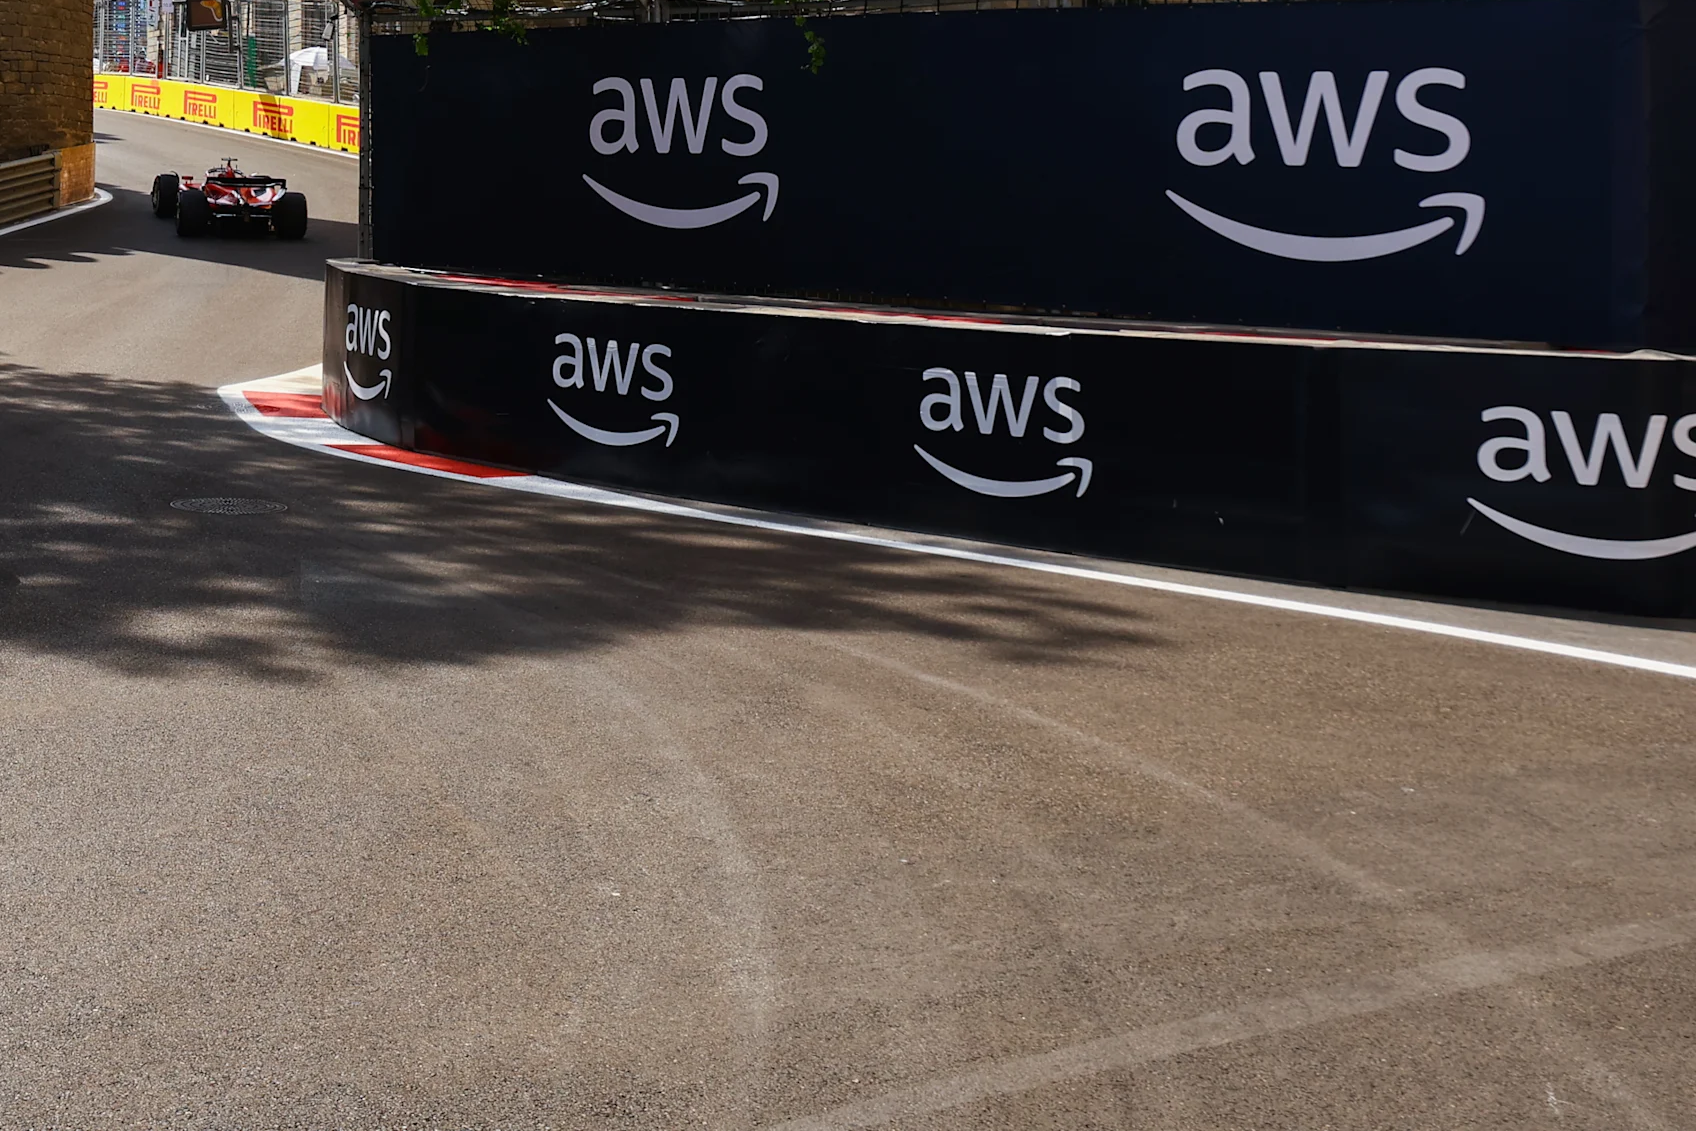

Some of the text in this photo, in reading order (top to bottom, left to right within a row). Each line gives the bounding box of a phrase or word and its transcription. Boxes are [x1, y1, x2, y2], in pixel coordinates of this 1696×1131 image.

[93, 81, 109, 104] ELLI
[131, 83, 161, 110] PIRELLI
[184, 90, 217, 119] PIRELLI
[253, 101, 294, 134] PIRELLI
[590, 74, 768, 157] aws
[1176, 67, 1471, 172] aws
[345, 303, 391, 360] aws
[552, 333, 674, 401] aws
[919, 367, 1086, 444] aws
